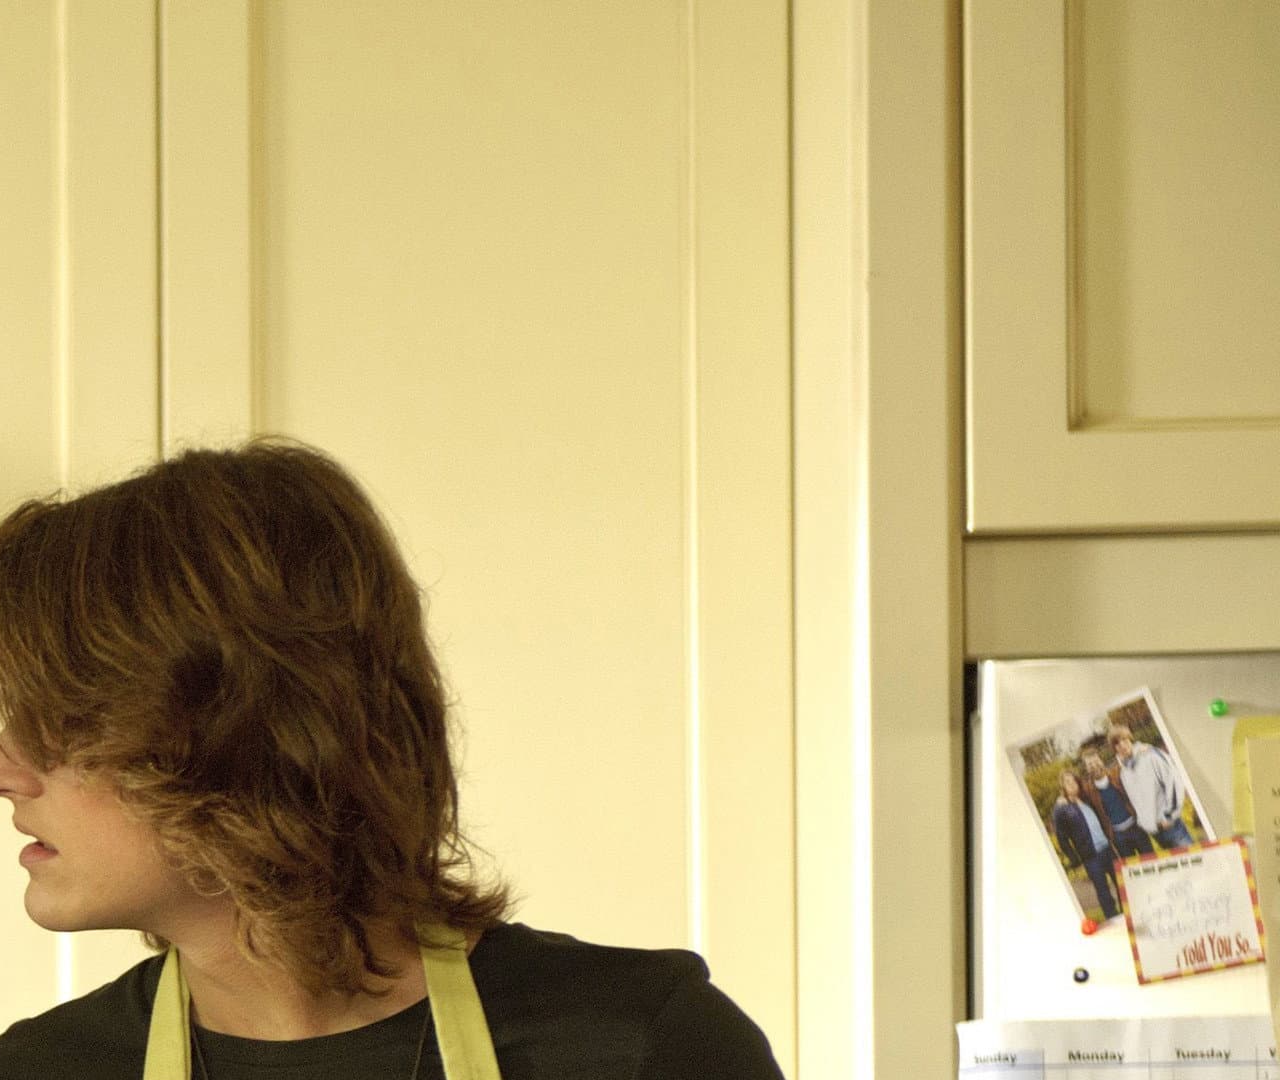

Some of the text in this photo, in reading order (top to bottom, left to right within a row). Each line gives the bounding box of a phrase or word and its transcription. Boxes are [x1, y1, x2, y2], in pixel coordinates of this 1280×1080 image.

[1208, 930, 1233, 961] You
[1068, 1049, 1125, 1064] Monday
[1175, 1048, 1231, 1063] Tuesday
